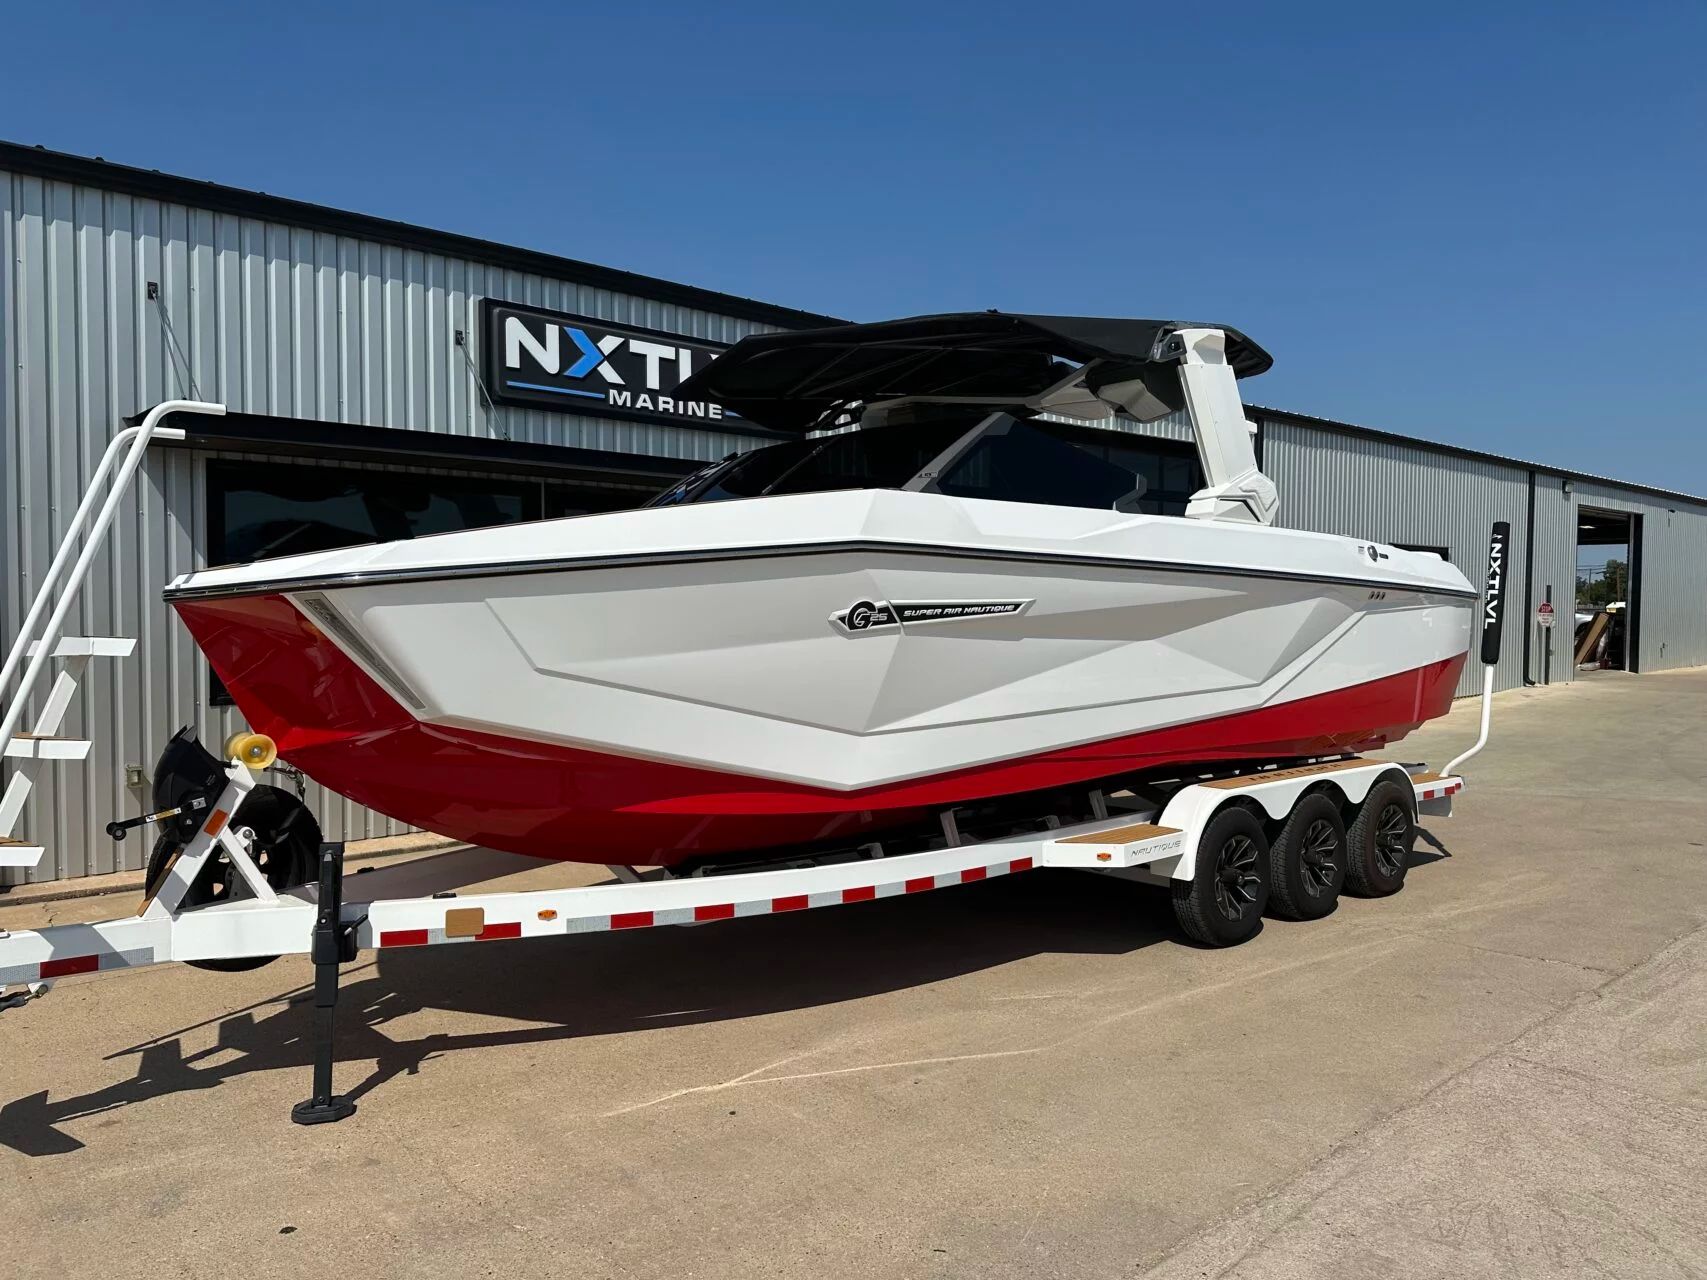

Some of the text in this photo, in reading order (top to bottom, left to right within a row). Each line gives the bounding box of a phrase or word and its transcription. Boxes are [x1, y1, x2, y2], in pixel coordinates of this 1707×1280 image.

[505, 316, 720, 390] NXTL
[608, 388, 723, 420] MARINE
[1484, 543, 1502, 629] NXTLVL
[903, 604, 1015, 617] SUPER AIR NAUTIQUE
[1131, 840, 1182, 857] NAUTIQUE
